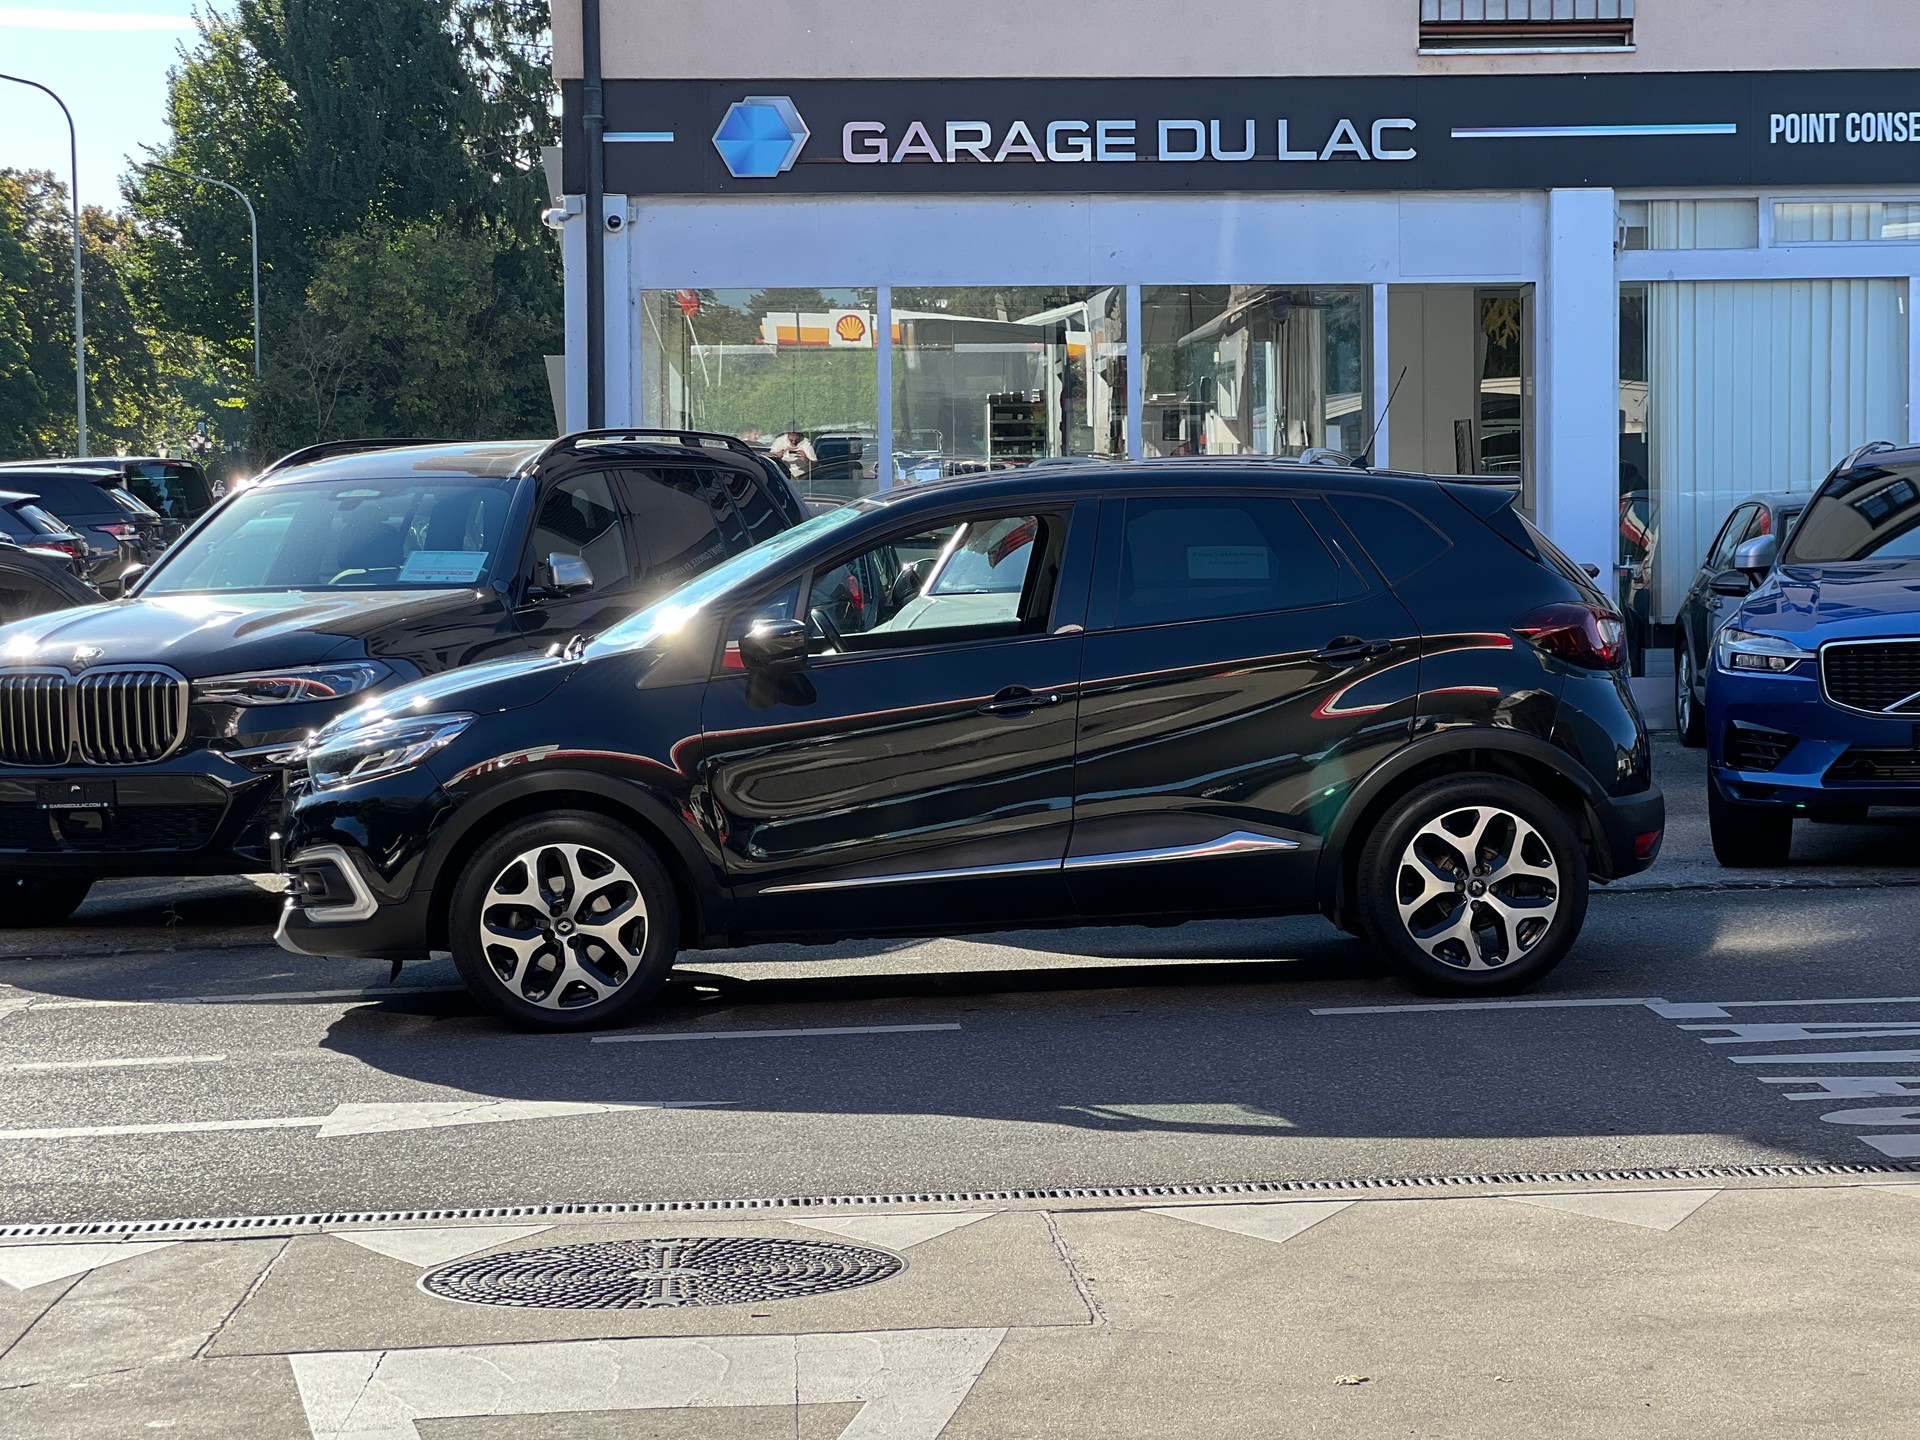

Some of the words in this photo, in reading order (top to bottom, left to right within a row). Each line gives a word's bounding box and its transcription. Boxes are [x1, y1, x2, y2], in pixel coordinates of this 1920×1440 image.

[842, 120, 1137, 163] GARAGE
[1158, 119, 1255, 161] DU
[1278, 118, 1417, 161] LAC
[1770, 113, 1840, 144] POINT
[1845, 111, 1920, 143] CONSE
